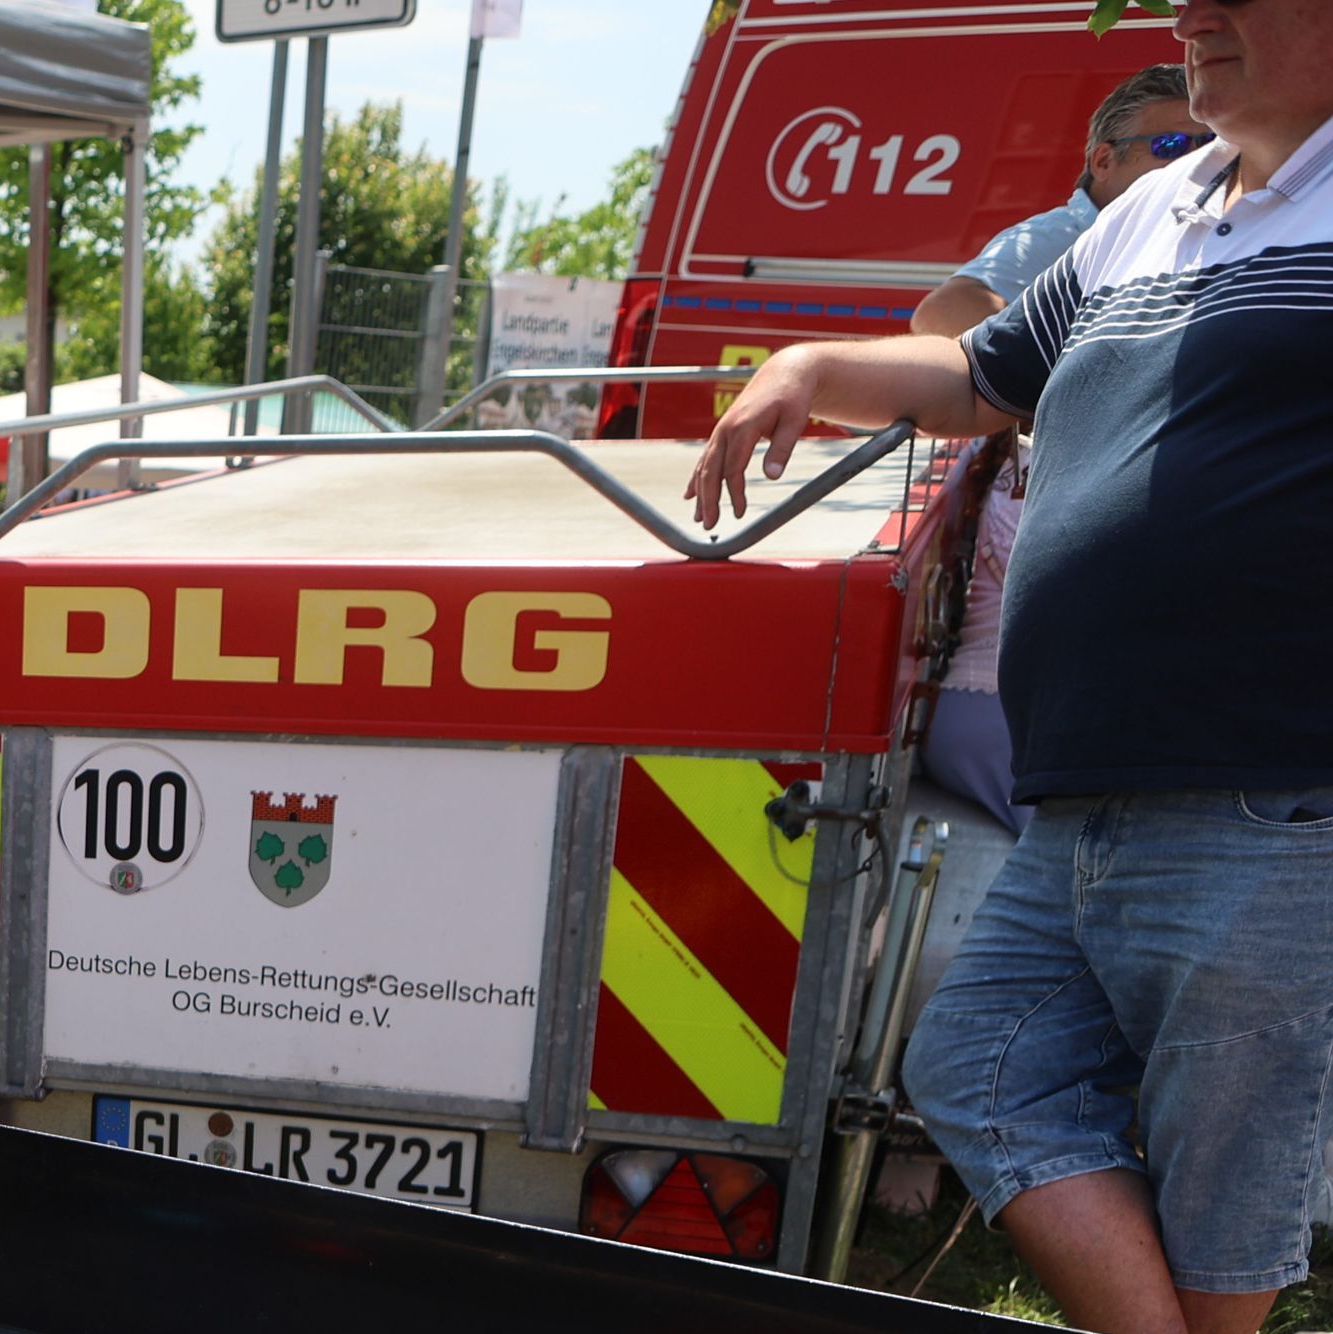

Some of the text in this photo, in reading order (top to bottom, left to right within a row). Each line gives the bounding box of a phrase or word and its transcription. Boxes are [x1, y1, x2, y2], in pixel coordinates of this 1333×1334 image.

[827, 134, 961, 194] 112
[494, 337, 578, 365] Engelskirchen
[501, 309, 569, 335] Landpartie
[22, 585, 613, 691] DLRG
[74, 768, 188, 863] 100
[47, 949, 538, 1008] Deutsche Lebens-Rettungs-Gesellschaft
[171, 990, 391, 1029] OG Burscheid e.V.
[134, 1110, 466, 1198] GL LR 3721
